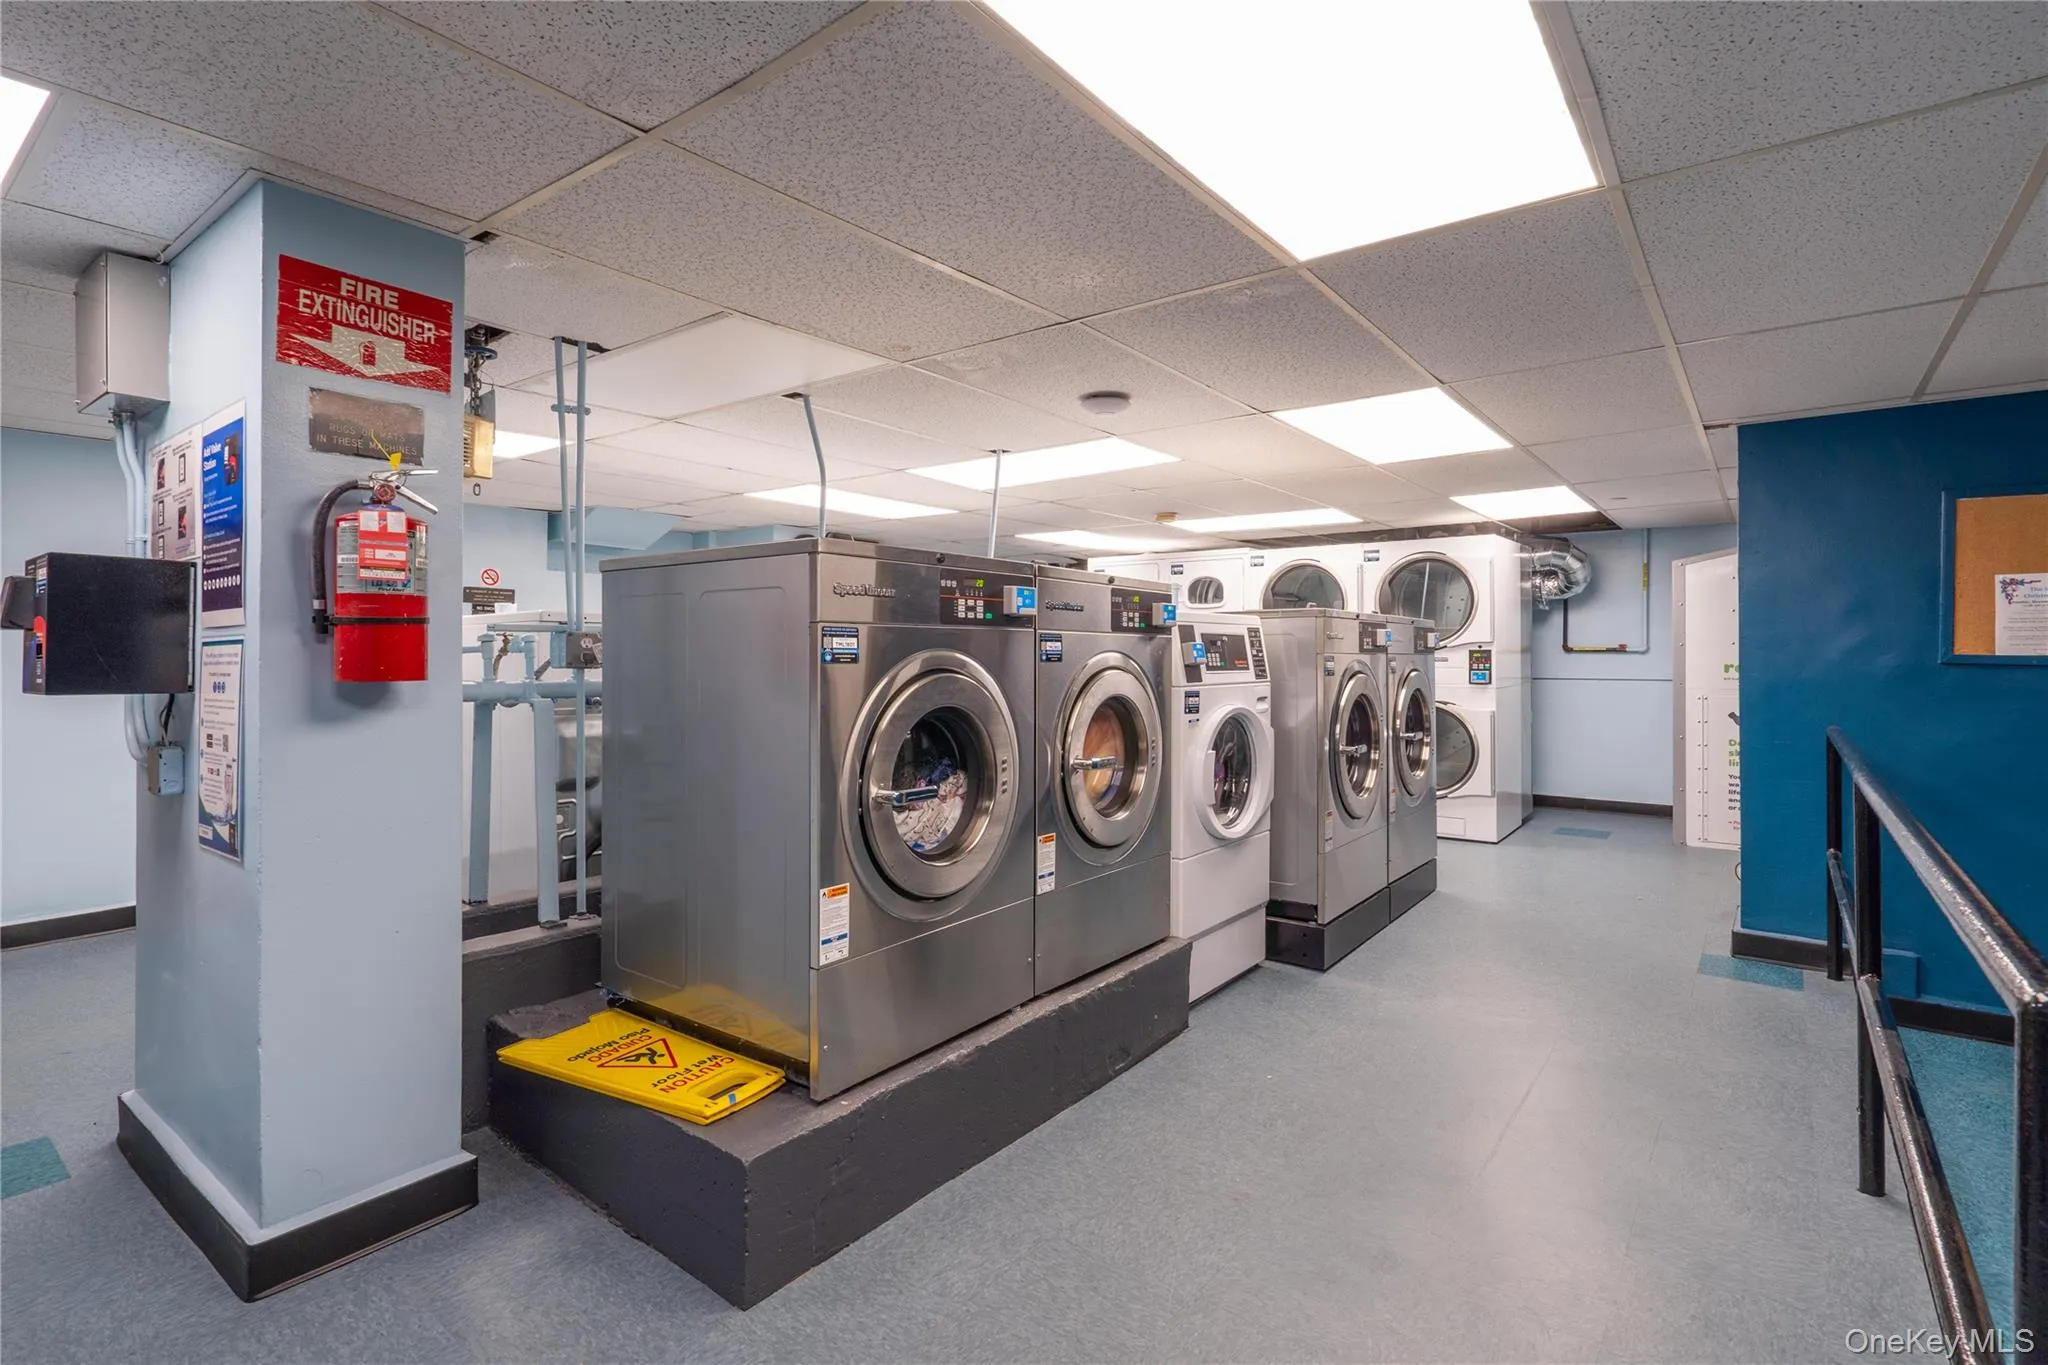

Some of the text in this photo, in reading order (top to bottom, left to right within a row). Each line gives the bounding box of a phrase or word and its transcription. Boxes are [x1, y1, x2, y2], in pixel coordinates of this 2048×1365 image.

[340, 276, 400, 309] FIRE
[298, 288, 436, 345] EXTINGUISHER
[316, 433, 417, 455] IN THESE MACHINES
[329, 422, 356, 435] RUGS
[567, 1027, 650, 1061] Piso Mojado
[588, 1035, 652, 1062] CUIDADO
[651, 1054, 723, 1088] Wet Floor
[659, 1056, 735, 1094] CAUTION
